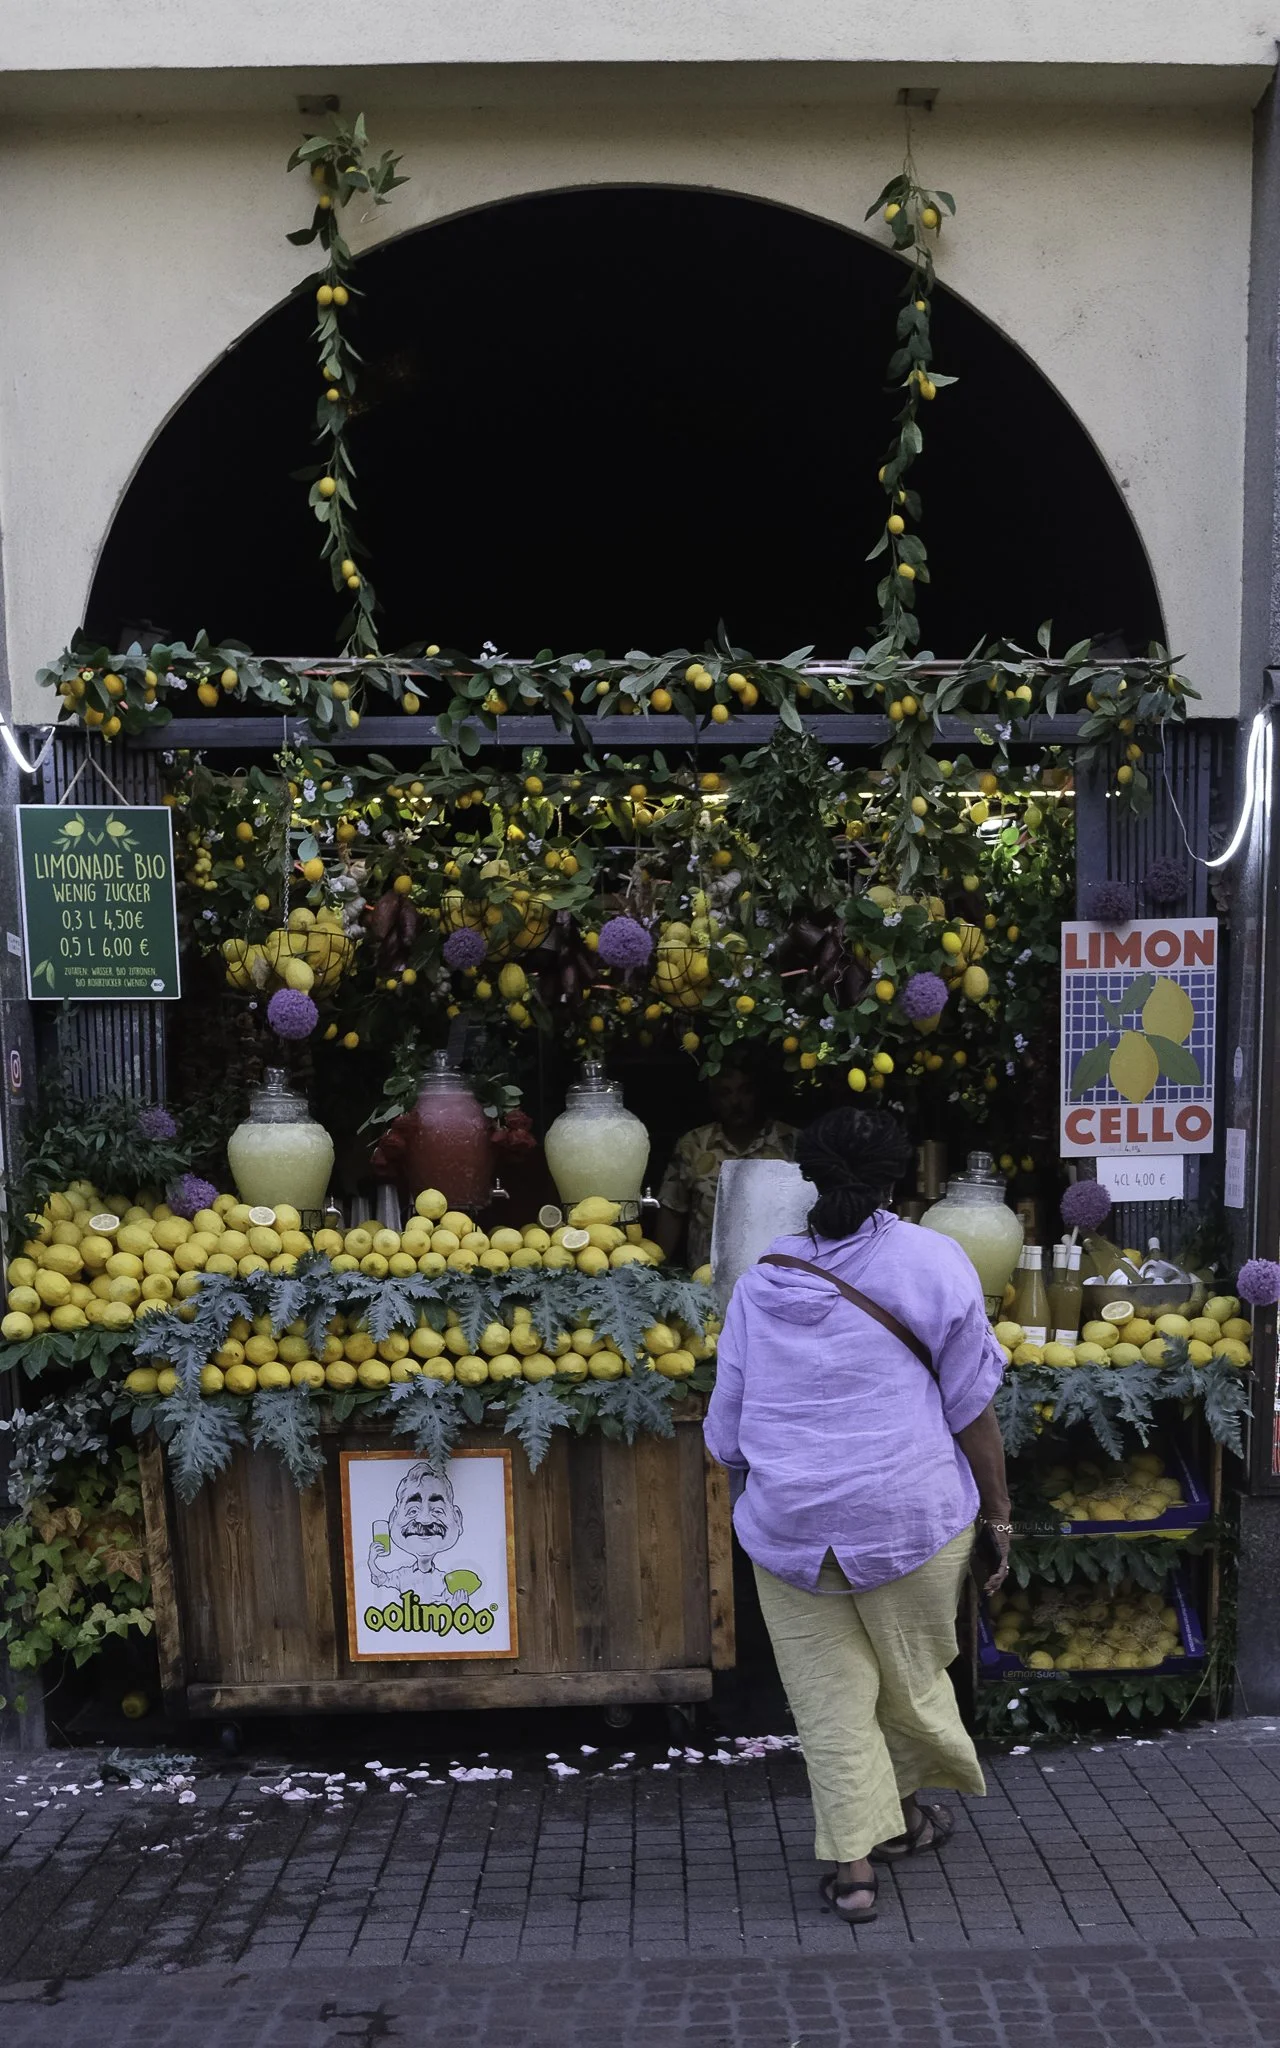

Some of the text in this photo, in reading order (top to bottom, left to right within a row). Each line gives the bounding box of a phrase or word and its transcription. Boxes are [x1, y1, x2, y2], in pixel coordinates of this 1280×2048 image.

[34, 853, 166, 880] LIMONADE BIO
[53, 883, 151, 903] WENIG ZUCKER
[89, 910, 97, 930] L
[88, 937, 96, 957] L
[140, 938, 150, 957] €
[1064, 929, 1215, 969] LIMON
[1064, 1105, 1213, 1145] CELLO
[1159, 1172, 1166, 1186] €
